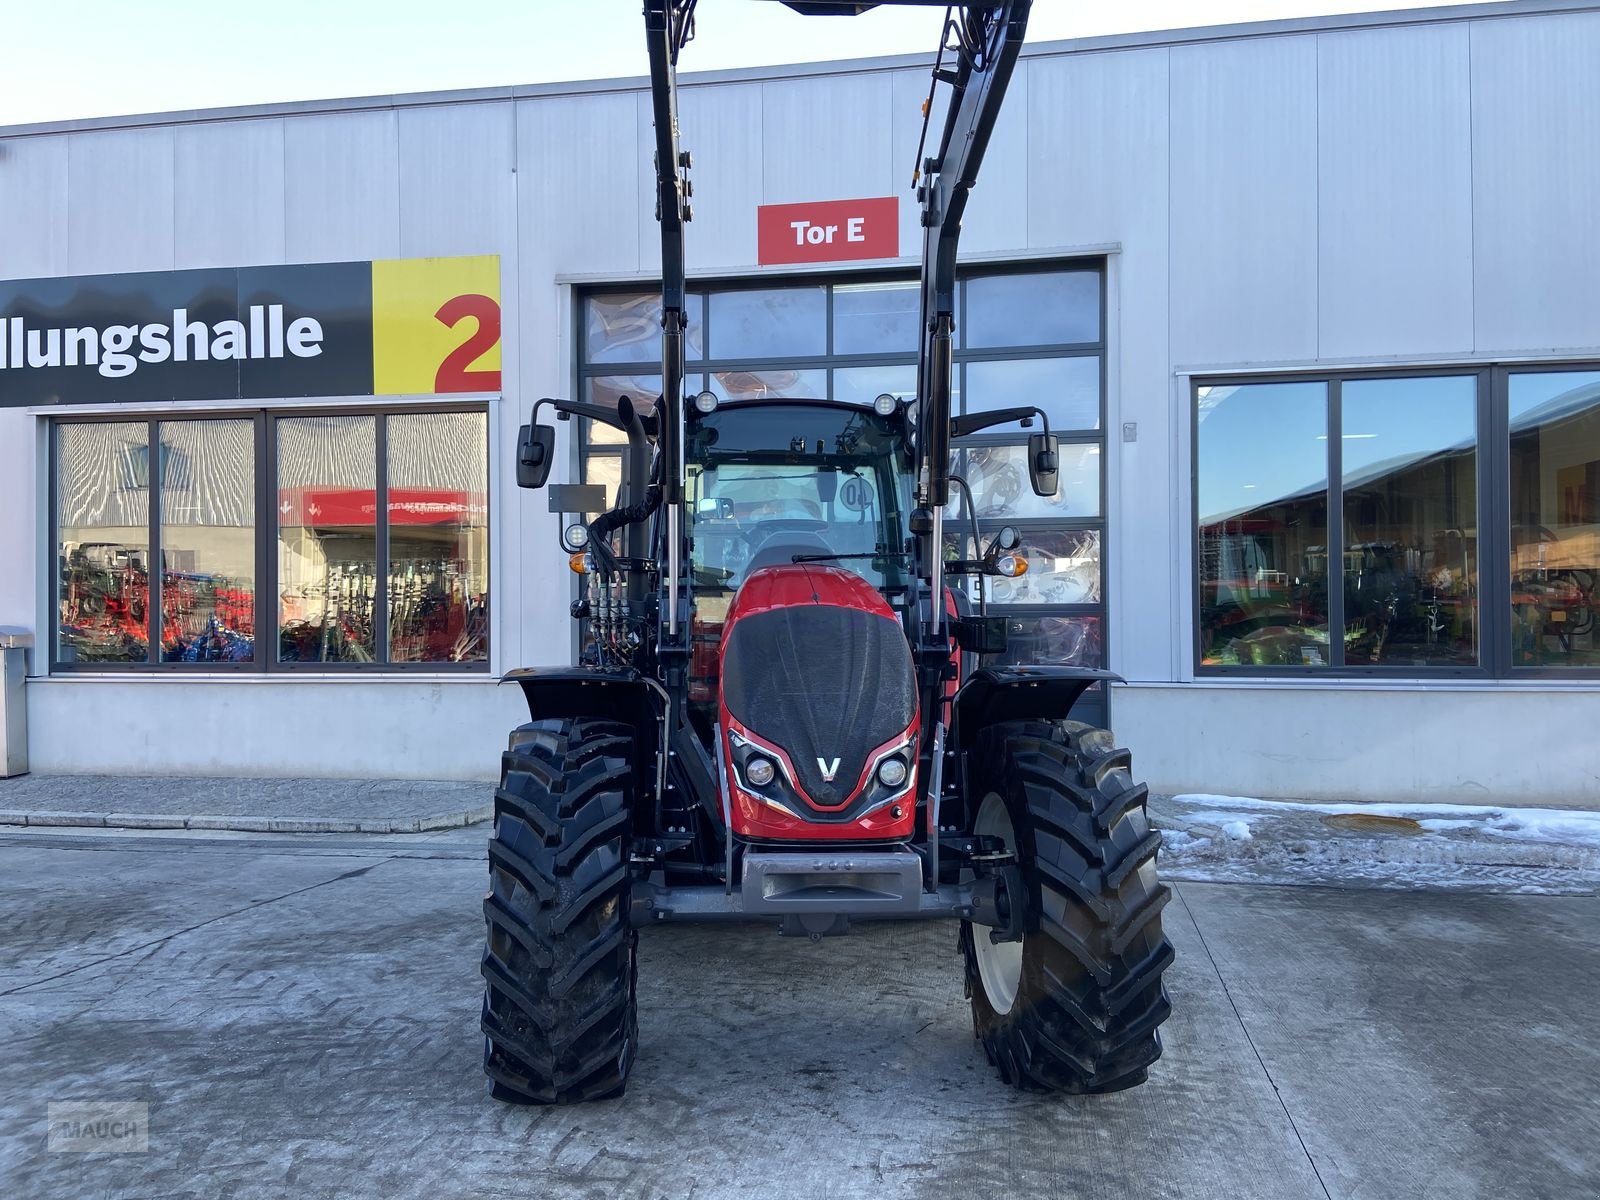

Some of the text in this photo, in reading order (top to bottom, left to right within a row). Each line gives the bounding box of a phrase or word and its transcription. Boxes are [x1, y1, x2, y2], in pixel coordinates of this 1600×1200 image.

[790, 217, 865, 245] Tor E
[434, 293, 502, 394] 2
[816, 757, 841, 783] V
